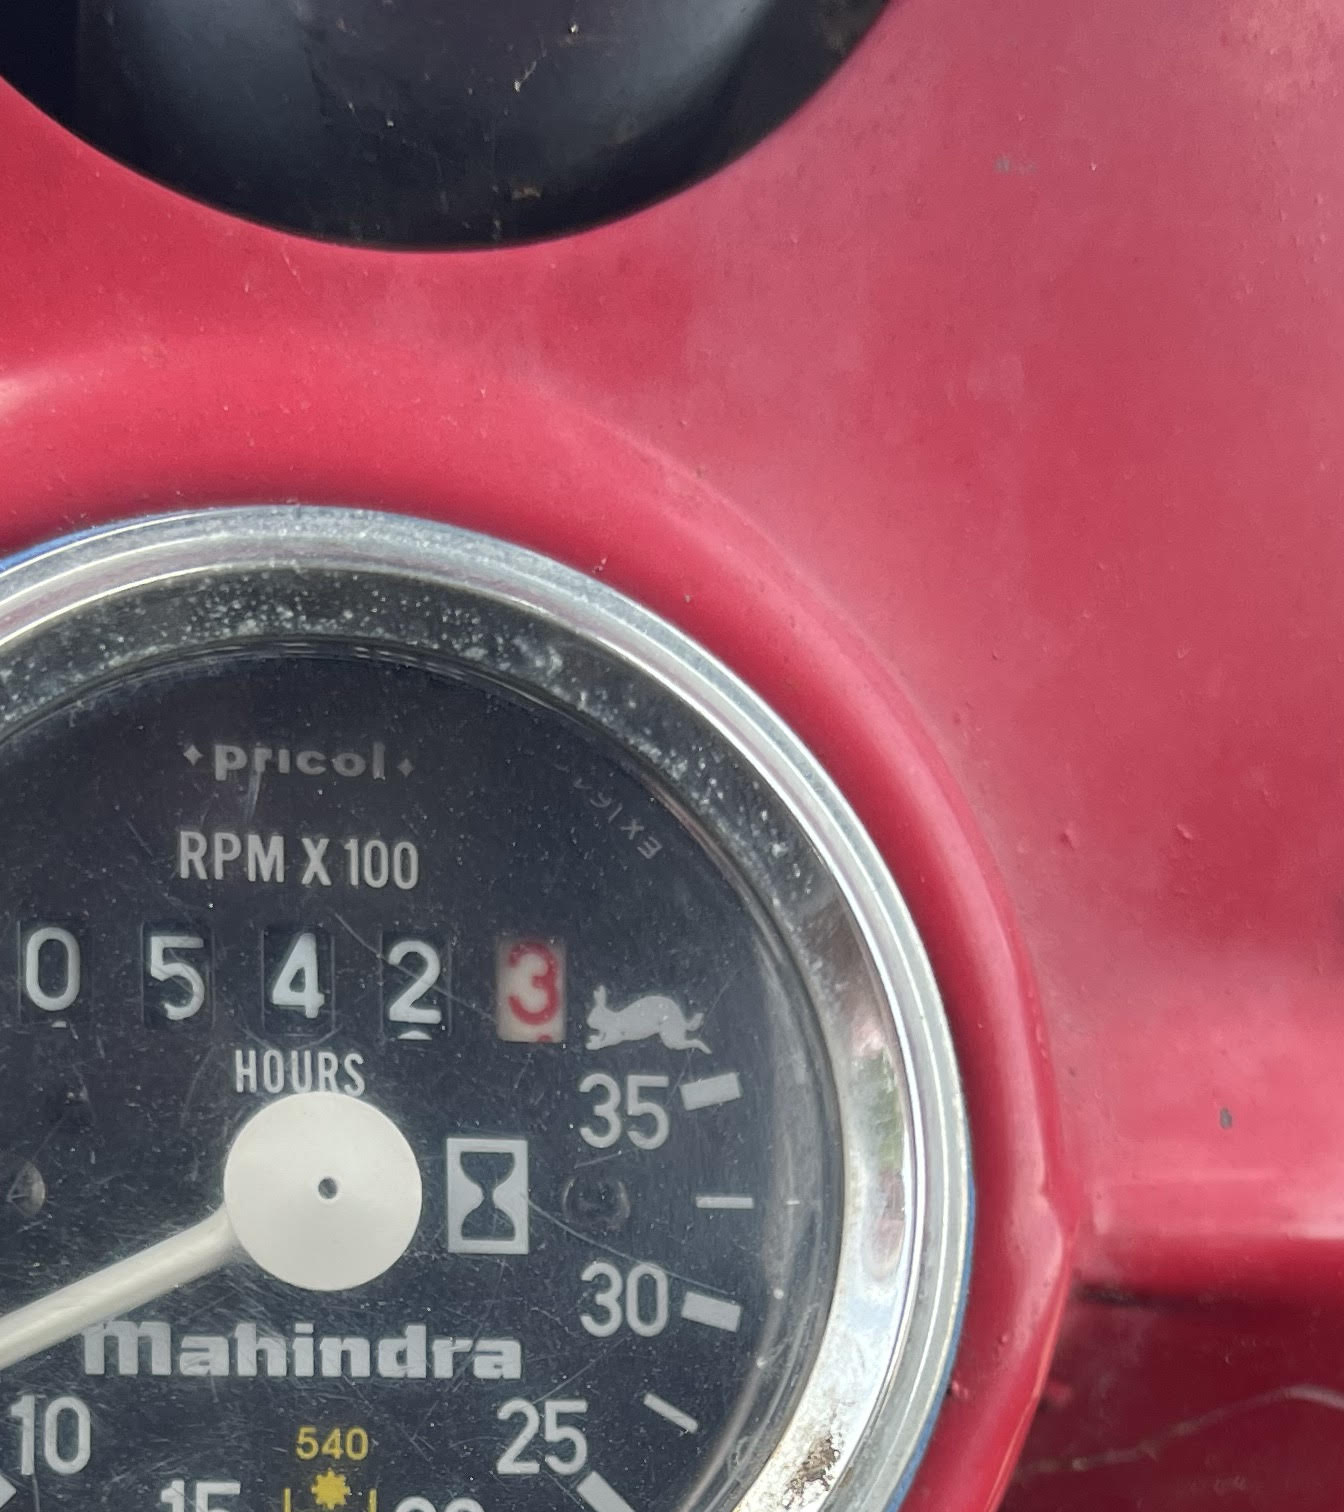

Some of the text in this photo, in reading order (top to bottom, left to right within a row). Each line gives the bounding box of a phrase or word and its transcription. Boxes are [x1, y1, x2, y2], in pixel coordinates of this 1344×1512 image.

[214, 742, 387, 781] pricol
[178, 830, 419, 891] RPM X 100
[234, 1048, 367, 1096] HOURS
[578, 1071, 670, 1151] 35
[579, 1259, 670, 1338] 30
[81, 1320, 523, 1380] Mahindra
[10, 1394, 93, 1477] 10
[295, 1424, 370, 1462] 540
[495, 1397, 589, 1476] 25
